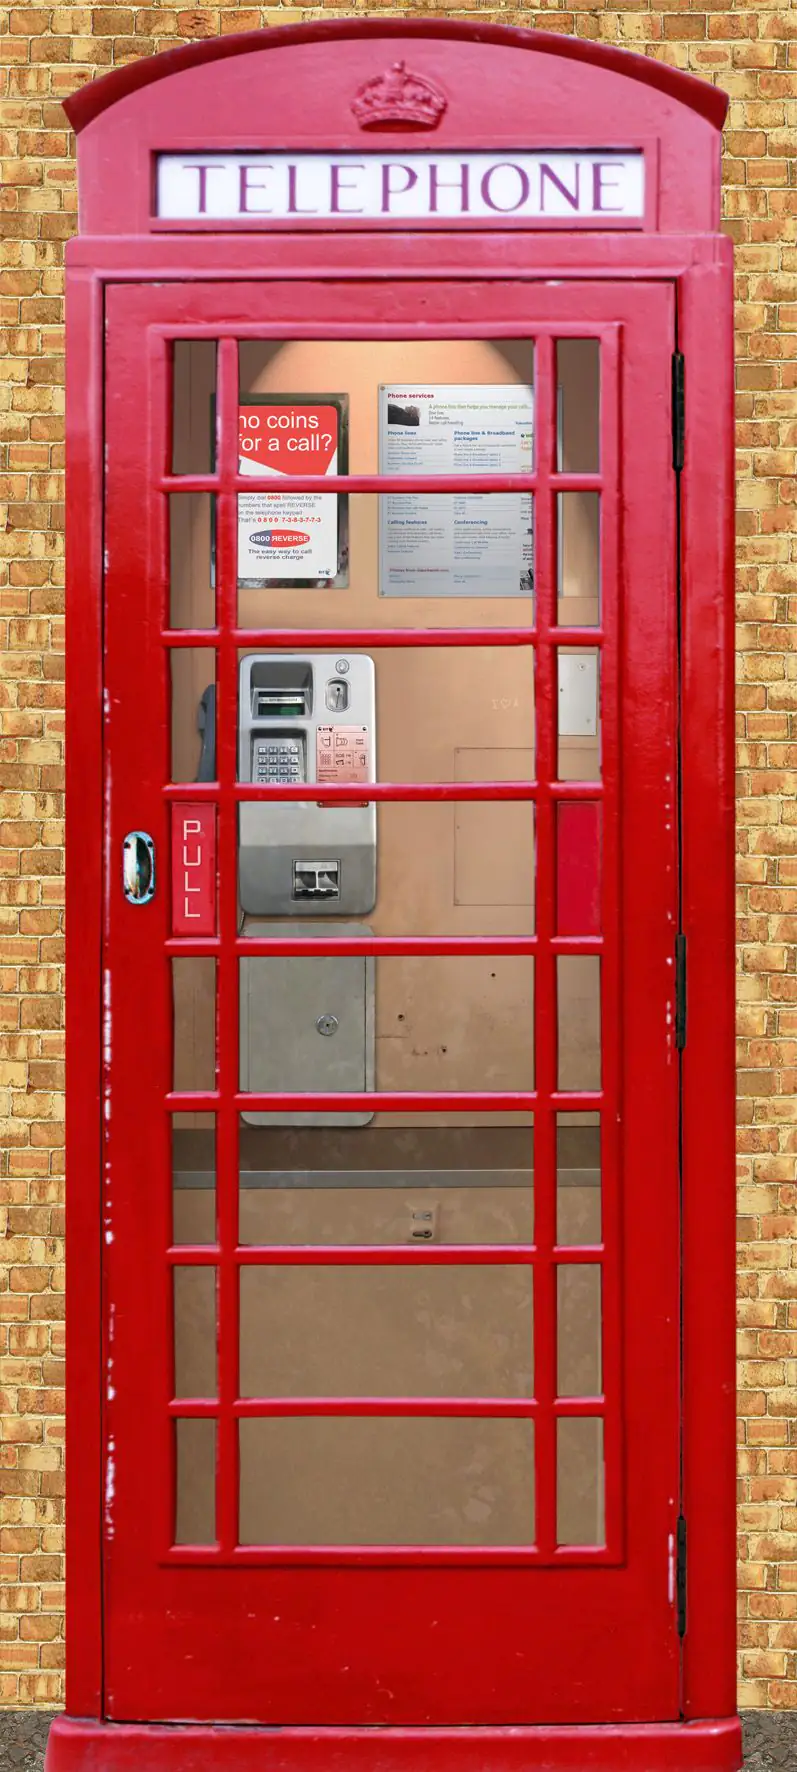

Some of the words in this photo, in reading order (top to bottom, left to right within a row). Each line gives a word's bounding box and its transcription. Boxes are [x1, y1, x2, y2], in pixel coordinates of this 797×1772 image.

[182, 162, 626, 214] TELEPHONE
[267, 411, 319, 429] coins
[268, 437, 280, 451] a
[287, 433, 333, 451] call?
[183, 820, 202, 918] PULL
